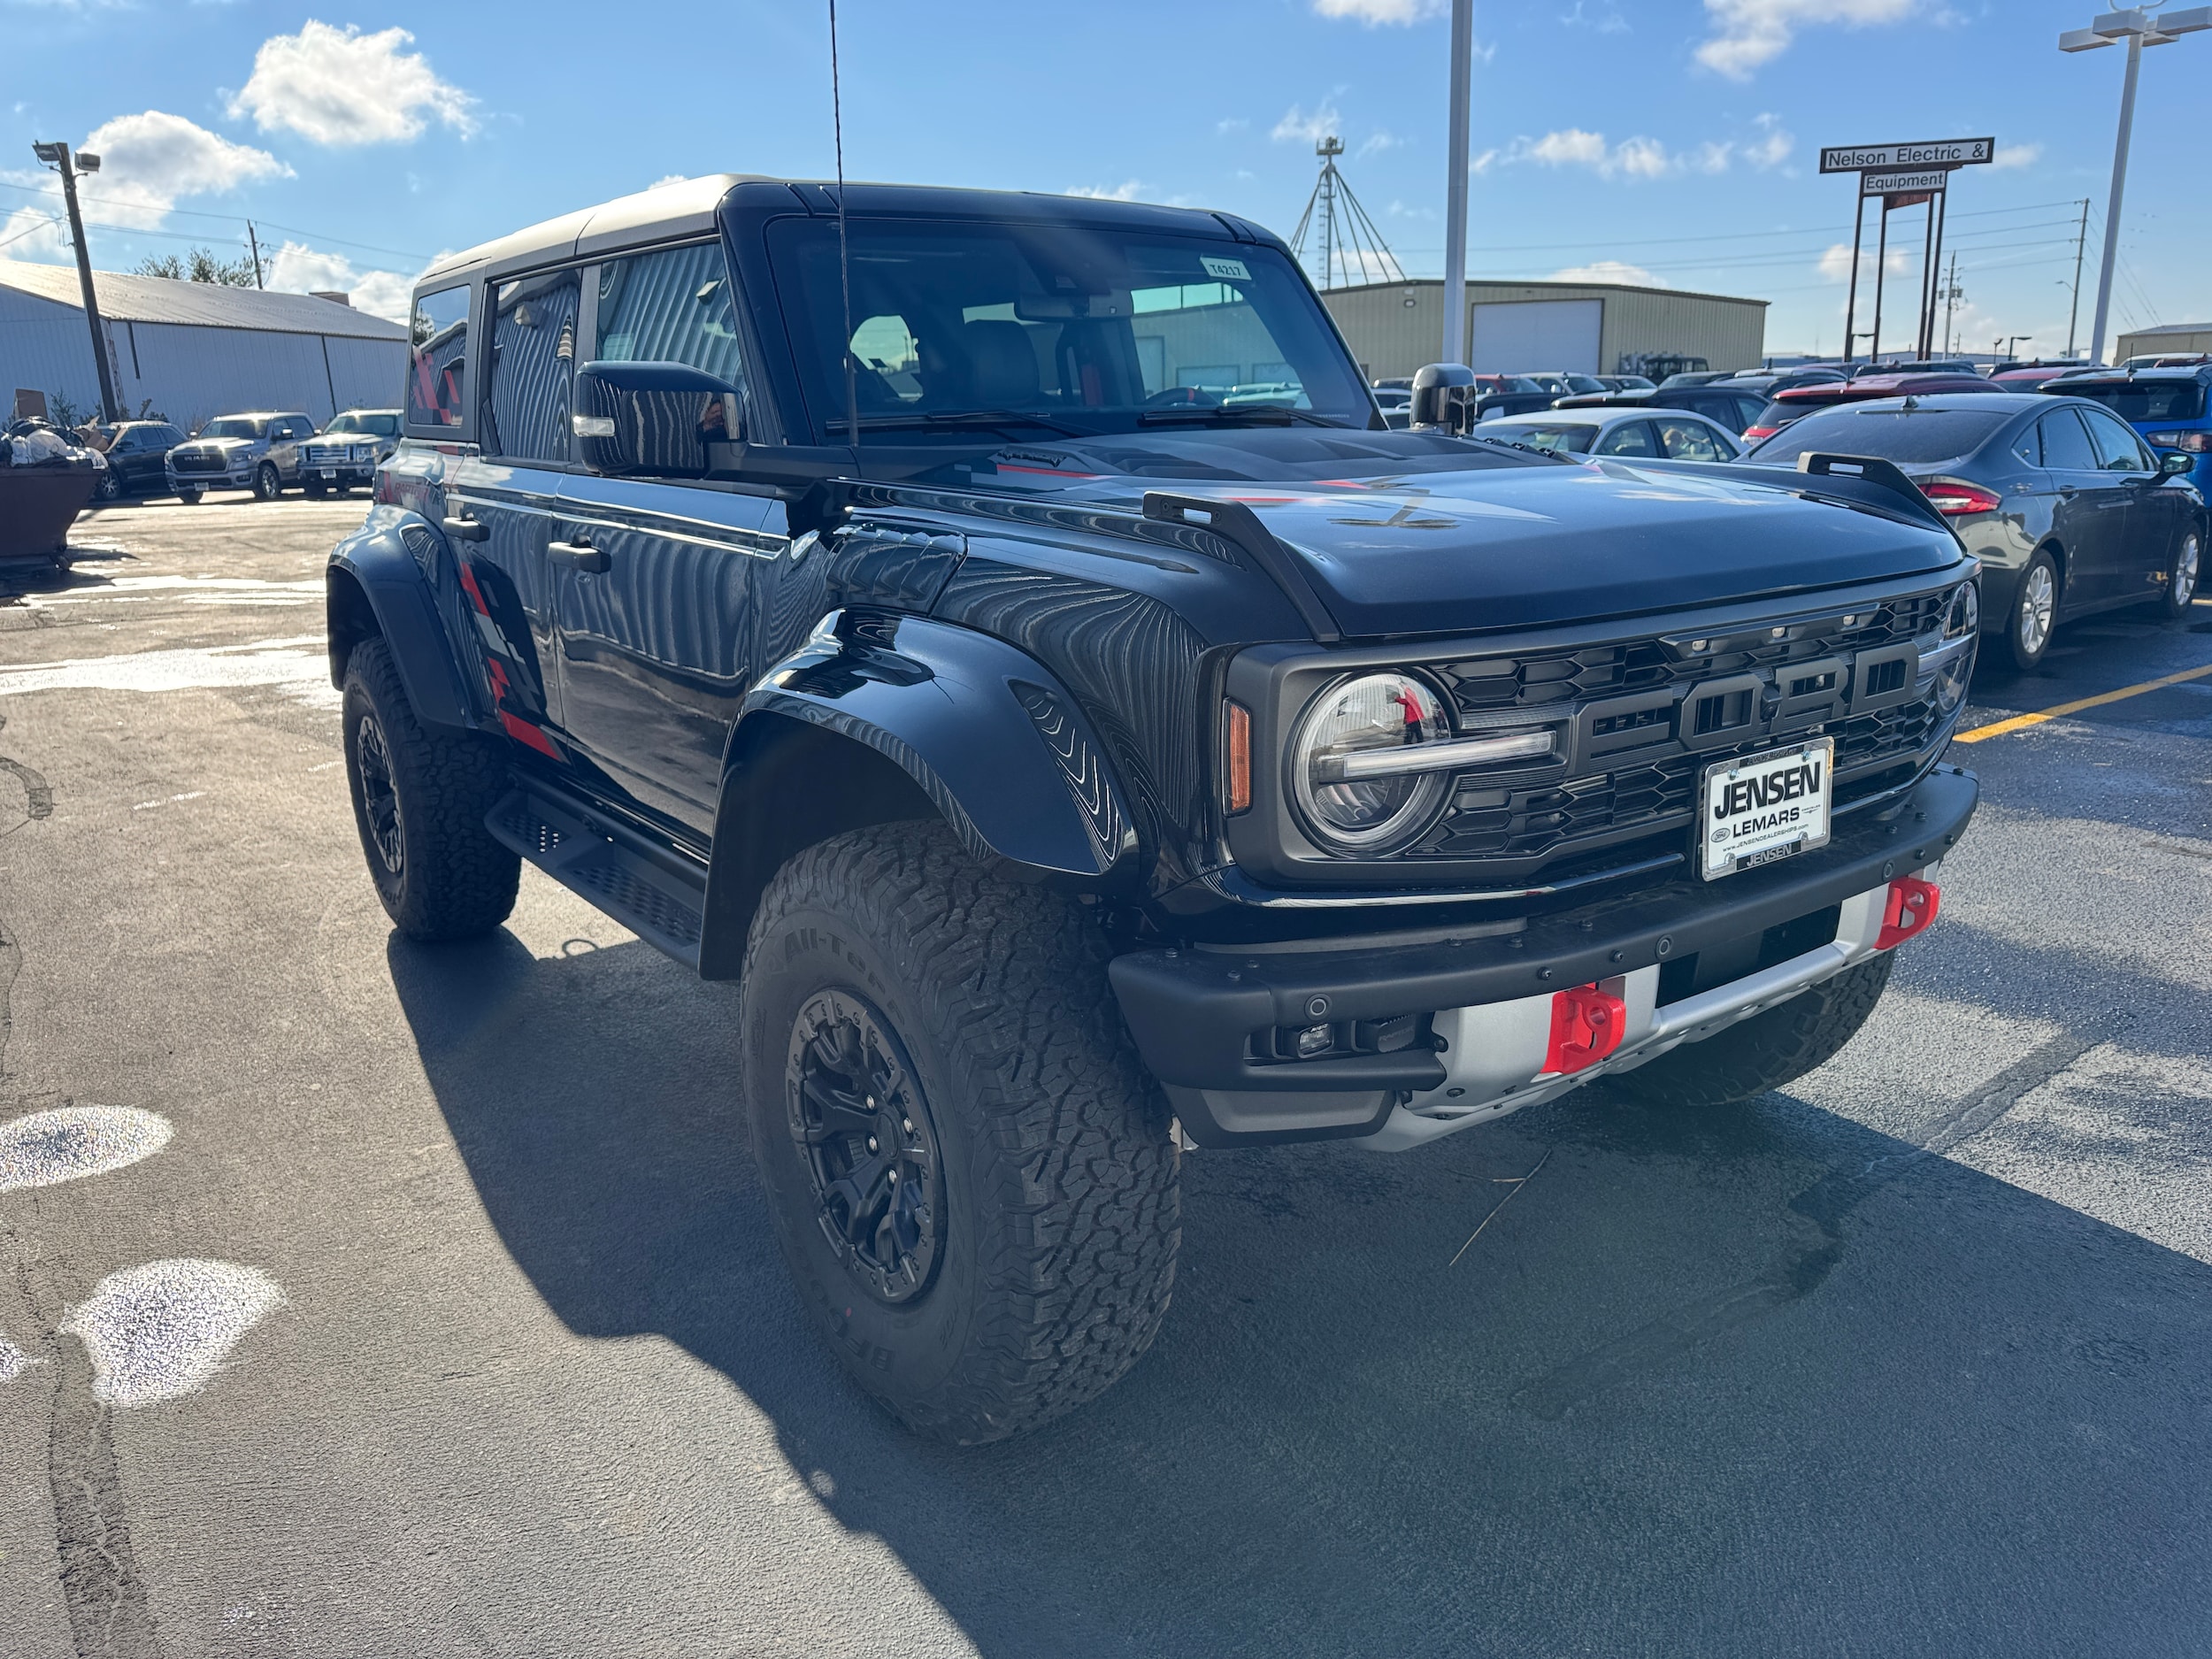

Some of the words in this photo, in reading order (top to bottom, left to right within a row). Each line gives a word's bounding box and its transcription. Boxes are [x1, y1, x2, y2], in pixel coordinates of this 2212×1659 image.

[1828, 151, 1886, 166] Nelson
[1896, 145, 1961, 163] Electric
[1972, 142, 1984, 157] &
[1866, 172, 1944, 190] Equipment
[1210, 265, 1241, 276] T4217
[1571, 641, 1920, 777] FORD
[1714, 761, 1821, 820] JENSEN
[1732, 806, 1801, 839] LEMARS
[1746, 843, 1793, 867] JENSEN
